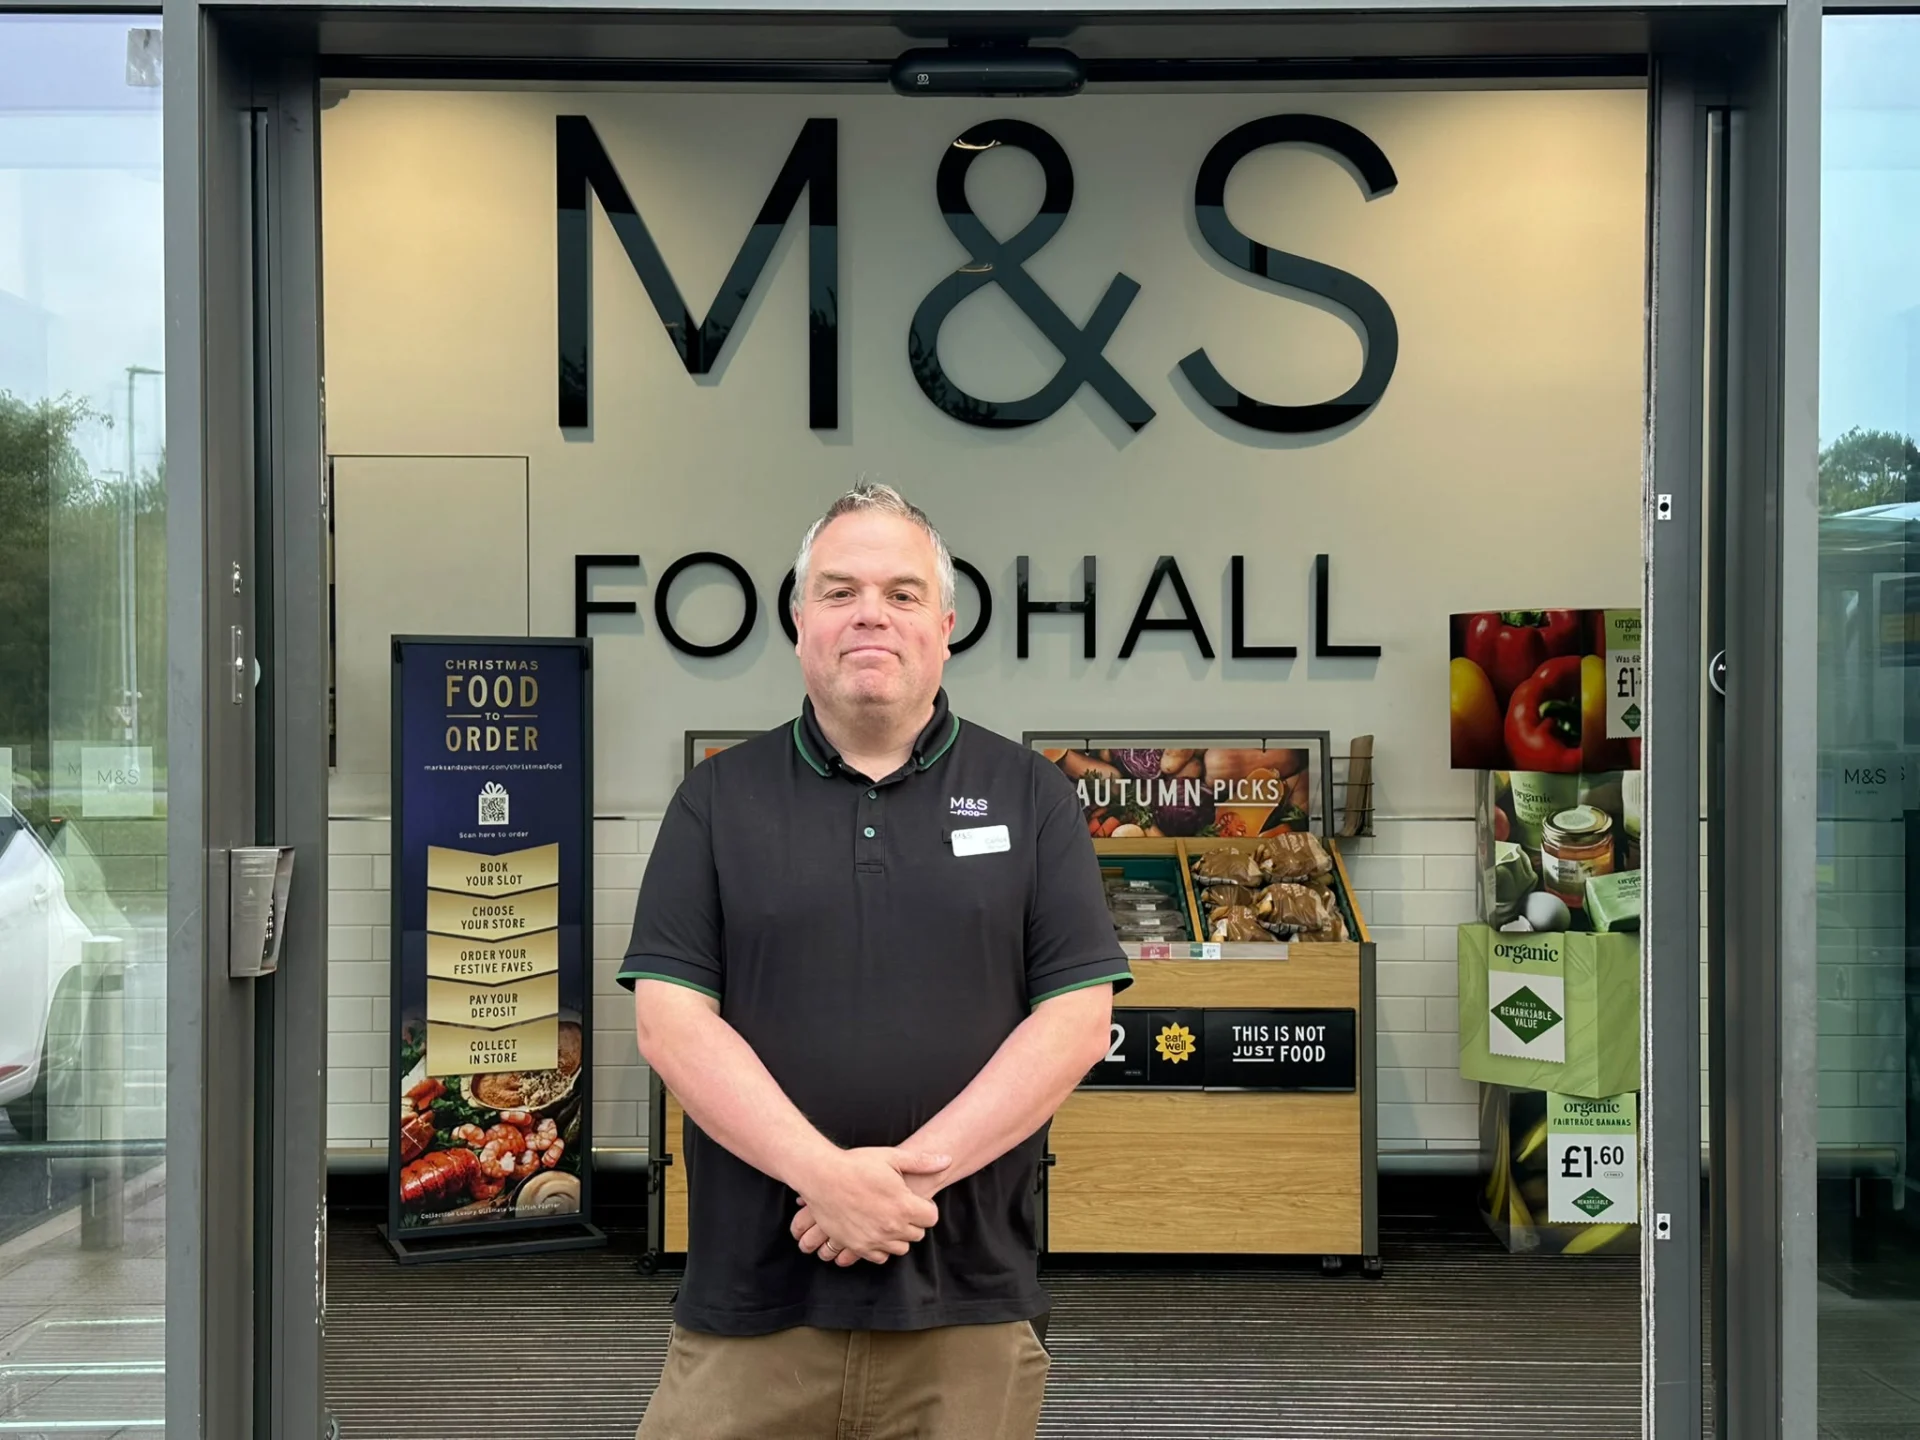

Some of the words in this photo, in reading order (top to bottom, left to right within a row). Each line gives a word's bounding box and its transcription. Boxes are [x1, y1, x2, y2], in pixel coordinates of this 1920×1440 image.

[556, 113, 1399, 434] M&S
[576, 551, 1382, 660] FOHALL
[445, 660, 539, 670] CHRISTMAS
[446, 675, 539, 708] FOOD
[485, 713, 500, 721] TO
[446, 726, 539, 752] ORDER
[424, 763, 563, 772] marksandspencer.com/christmasfood
[97, 769, 140, 785] M&S
[1844, 768, 1887, 785] M&S
[1076, 778, 1200, 807] AUTUMN
[1213, 779, 1280, 801] PICKS
[950, 797, 988, 811] M&S
[480, 862, 508, 873] BOOK
[466, 876, 494, 887] YOUR
[497, 875, 522, 885] SLOT
[472, 905, 515, 917] CHOOSE
[461, 920, 489, 930] YOUR
[492, 918, 526, 929] STORE
[460, 950, 496, 962] ORDER
[499, 949, 526, 960] YOUR
[1494, 943, 1559, 965] organic
[454, 964, 498, 975] FESTIVE
[501, 962, 533, 973] FAVES
[469, 994, 489, 1005] PAY
[490, 993, 518, 1004] YOUR
[471, 1007, 517, 1018] DEPOSIT
[1500, 1006, 1552, 1021] REMARKSABLE
[1514, 1017, 1538, 1029] VALUE
[1165, 1032, 1183, 1042] eat
[1233, 1026, 1268, 1041] THIS
[1275, 1026, 1288, 1041] IS
[1295, 1026, 1326, 1041] NOT
[470, 1039, 517, 1051] COLLECT
[1165, 1040, 1186, 1051] well
[469, 1055, 481, 1064] IN
[483, 1053, 517, 1064] STORE
[1232, 1045, 1275, 1057] JUST
[1280, 1045, 1326, 1062] FOOD
[1564, 1100, 1620, 1117] organic
[1553, 1118, 1594, 1126] FAIRTRADE
[1596, 1118, 1632, 1127] BANANAS
[1561, 1145, 1624, 1178] £1.60
